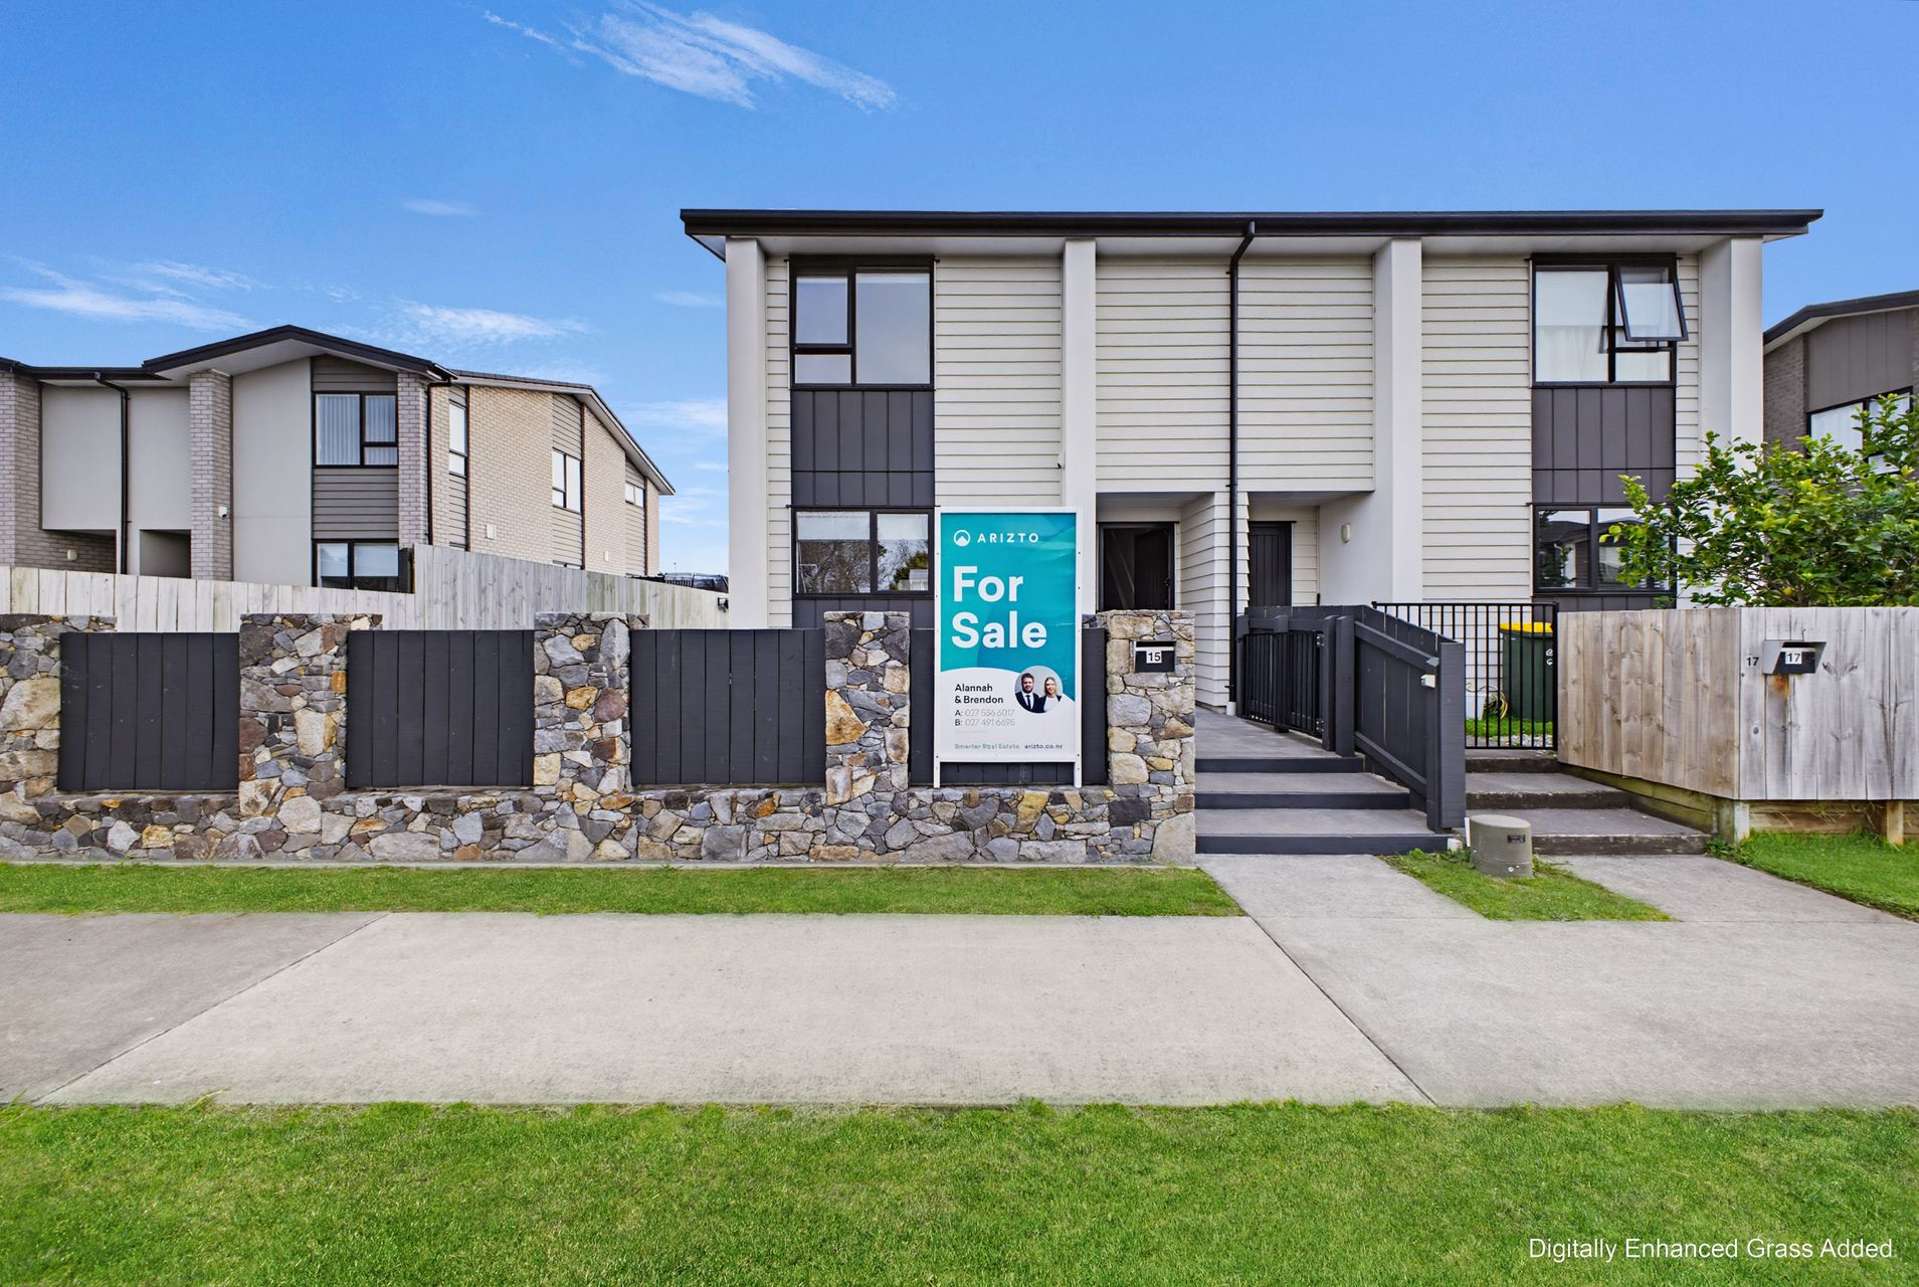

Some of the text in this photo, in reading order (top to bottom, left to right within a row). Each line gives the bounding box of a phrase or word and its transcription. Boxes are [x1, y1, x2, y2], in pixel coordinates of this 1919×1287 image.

[977, 532, 1039, 543] ARIZTO
[953, 566, 1024, 602] For
[951, 610, 1048, 649] Sale
[1147, 651, 1161, 662] 15
[1746, 656, 1760, 667] 17
[1786, 653, 1801, 663] 17
[954, 683, 993, 692] Alannah
[954, 695, 1004, 704] & Brendon
